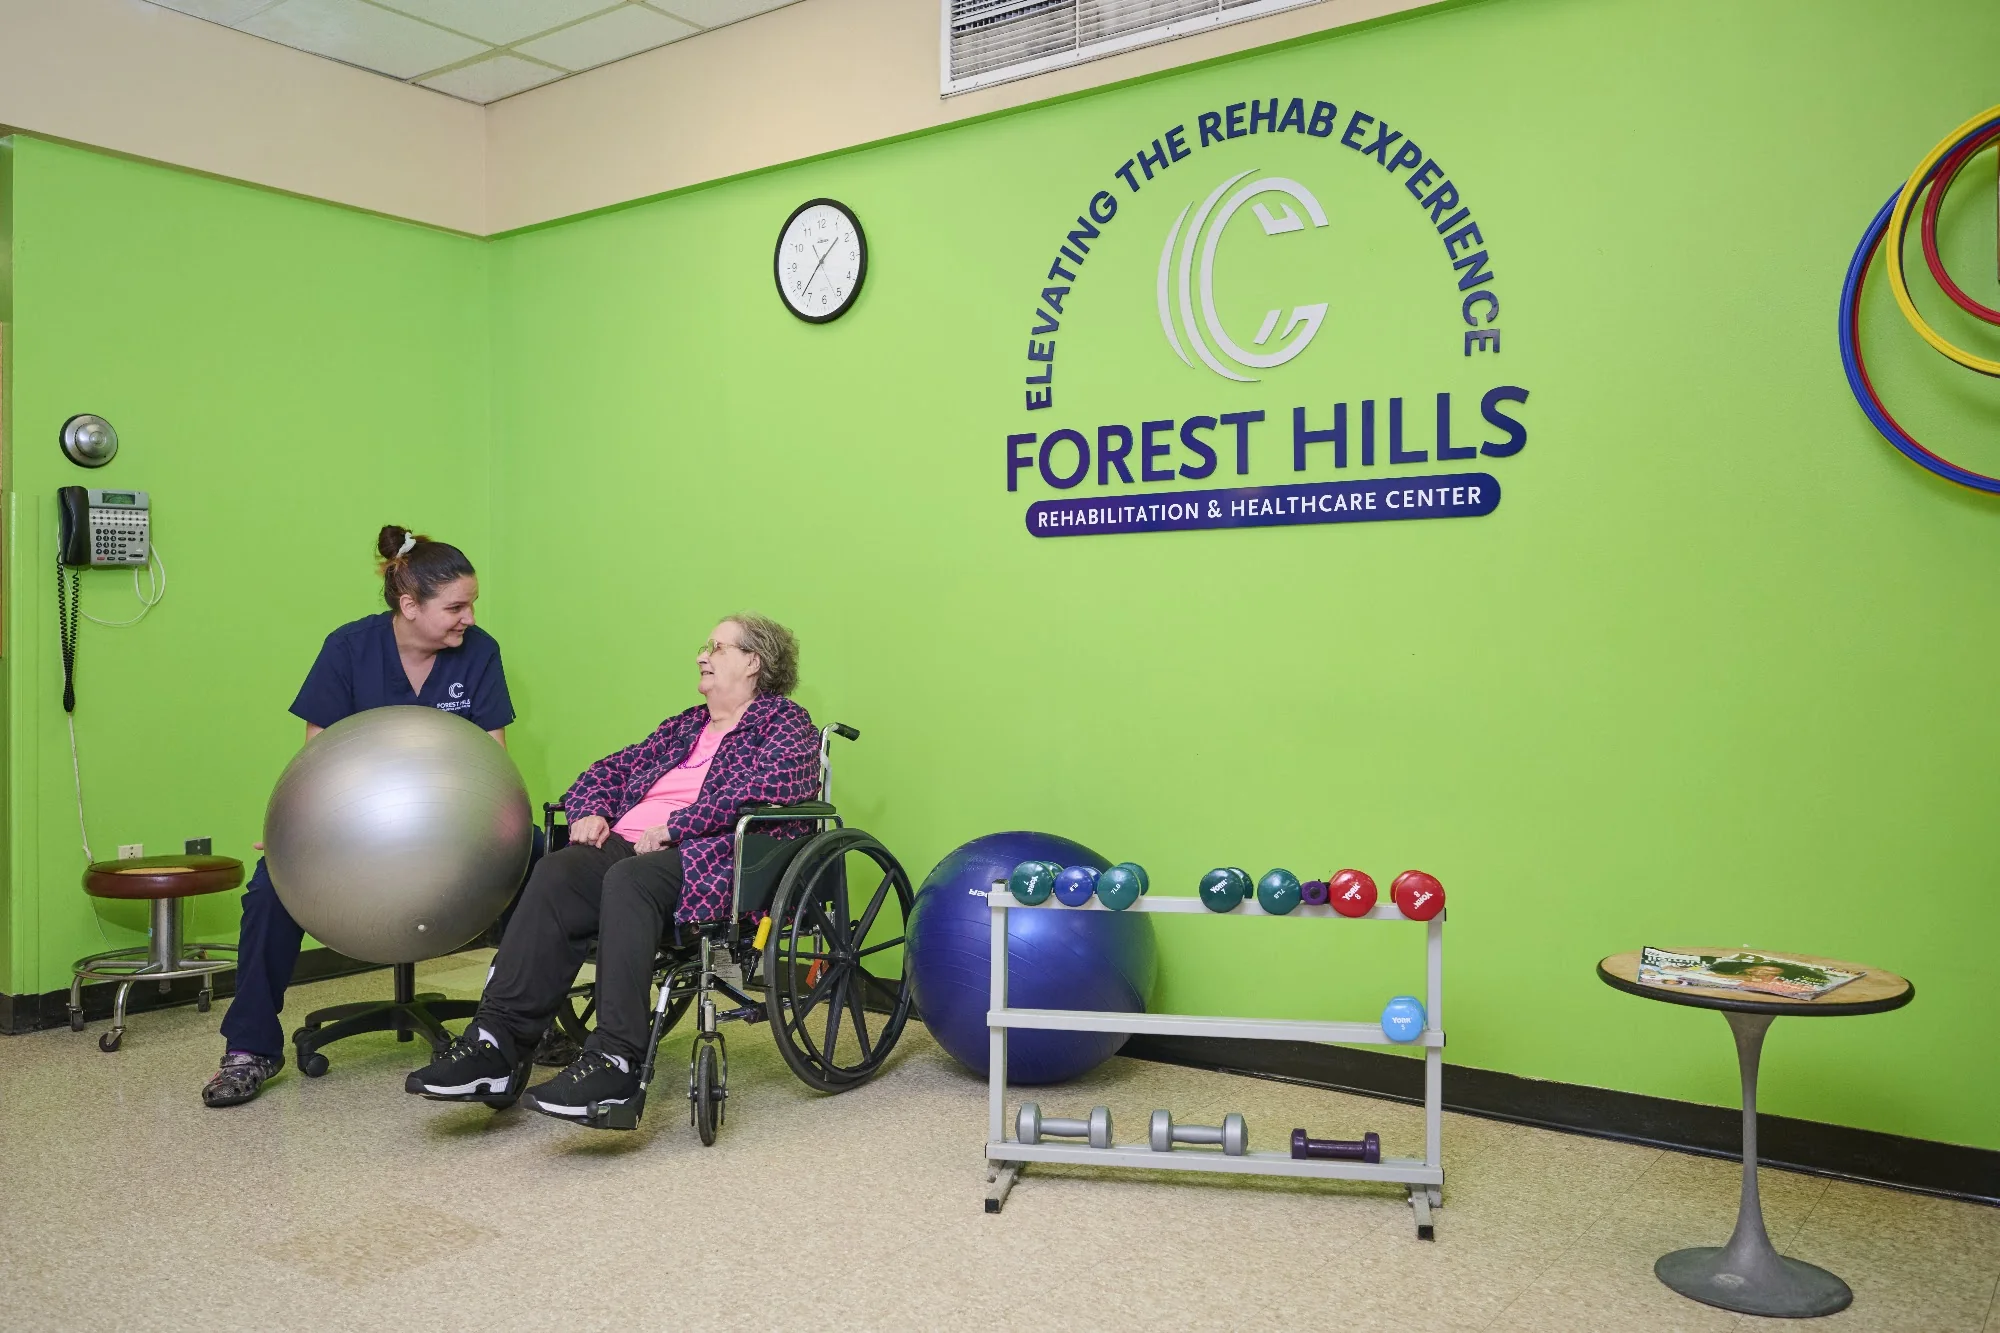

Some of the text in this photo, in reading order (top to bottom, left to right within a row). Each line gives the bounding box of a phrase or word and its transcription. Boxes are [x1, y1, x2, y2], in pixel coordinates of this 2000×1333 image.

[817, 219, 826, 229] 12
[803, 228, 812, 237] 11
[844, 233, 850, 242] 2
[794, 243, 804, 253] 10
[849, 251, 856, 261] 3
[1025, 98, 1500, 410] ELEVATING THE REHAB EXPERIENCE
[791, 262, 798, 273] 9
[846, 270, 851, 280] 4
[796, 280, 802, 290] 8
[807, 292, 813, 302] 7
[836, 287, 842, 297] 5
[821, 294, 828, 304] 6
[1005, 385, 1530, 492] FOREST HILLS
[1038, 485, 1482, 528] REHABILITATION & HEALTHCARE CENTER
